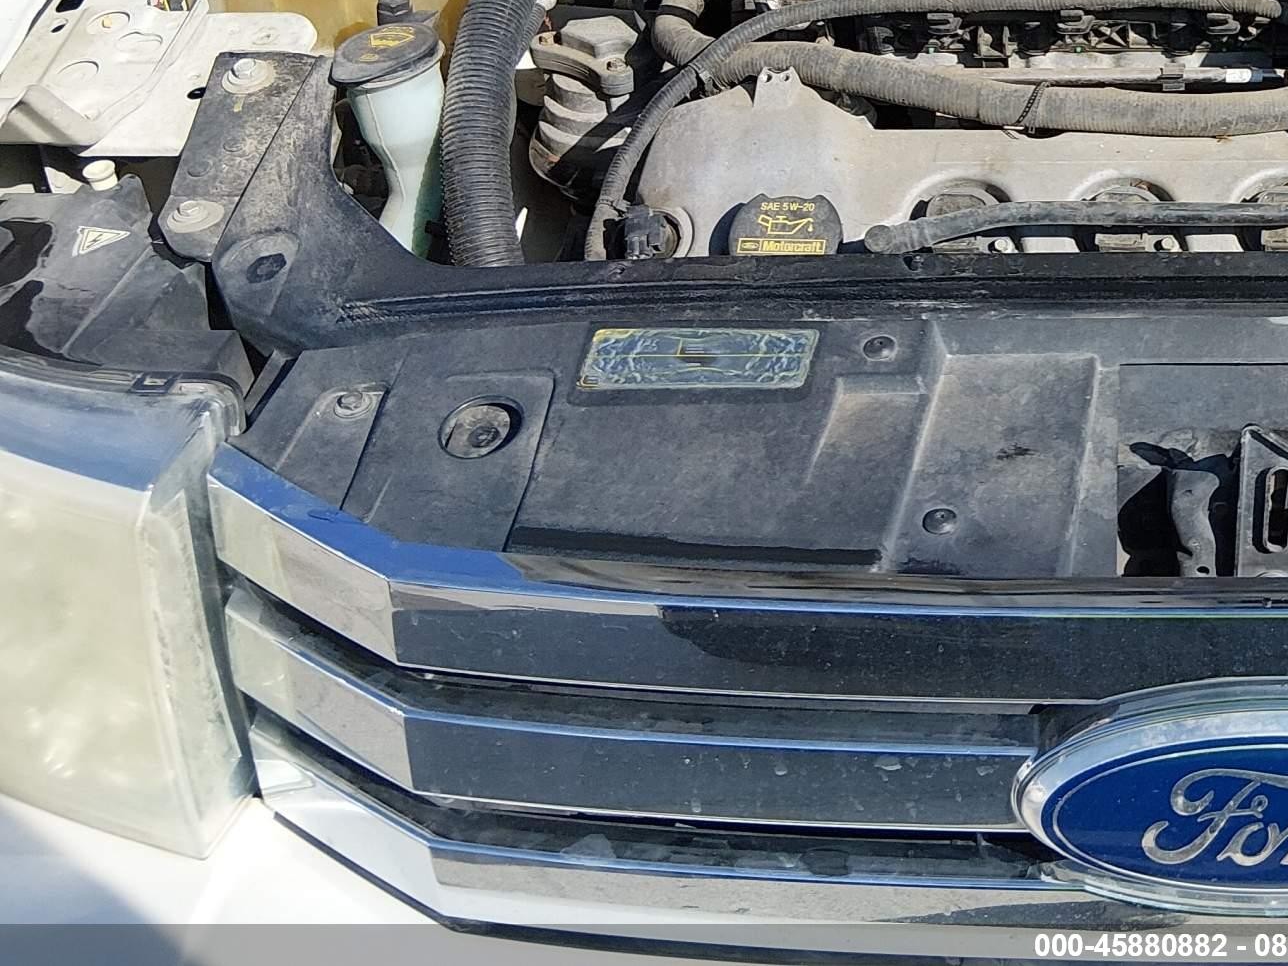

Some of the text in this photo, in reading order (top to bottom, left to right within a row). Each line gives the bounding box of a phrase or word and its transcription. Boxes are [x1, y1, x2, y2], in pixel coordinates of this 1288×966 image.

[760, 202, 815, 212] SAE 5W-20
[762, 240, 822, 253] Motorcraft
